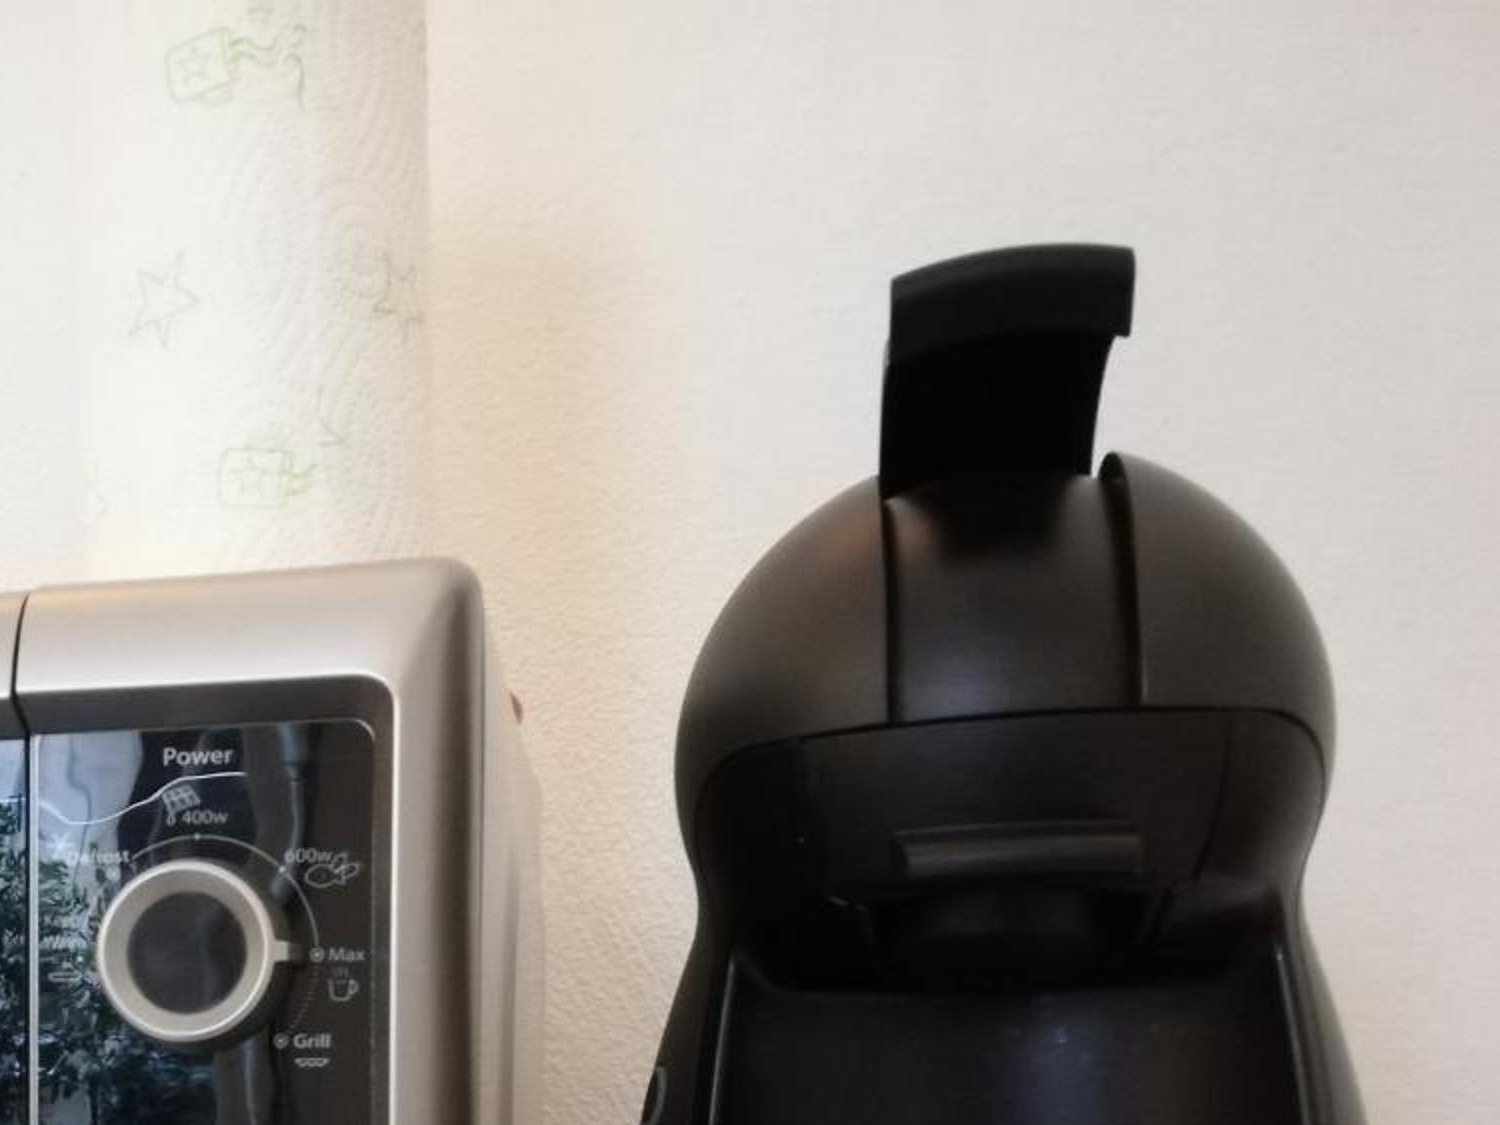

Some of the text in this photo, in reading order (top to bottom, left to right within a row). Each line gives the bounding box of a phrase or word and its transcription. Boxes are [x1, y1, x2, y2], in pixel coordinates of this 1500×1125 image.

[163, 747, 233, 766] Power
[181, 809, 228, 825] 400w
[284, 847, 333, 863] 600w
[329, 947, 365, 961] Max
[293, 1032, 332, 1049] Grill
